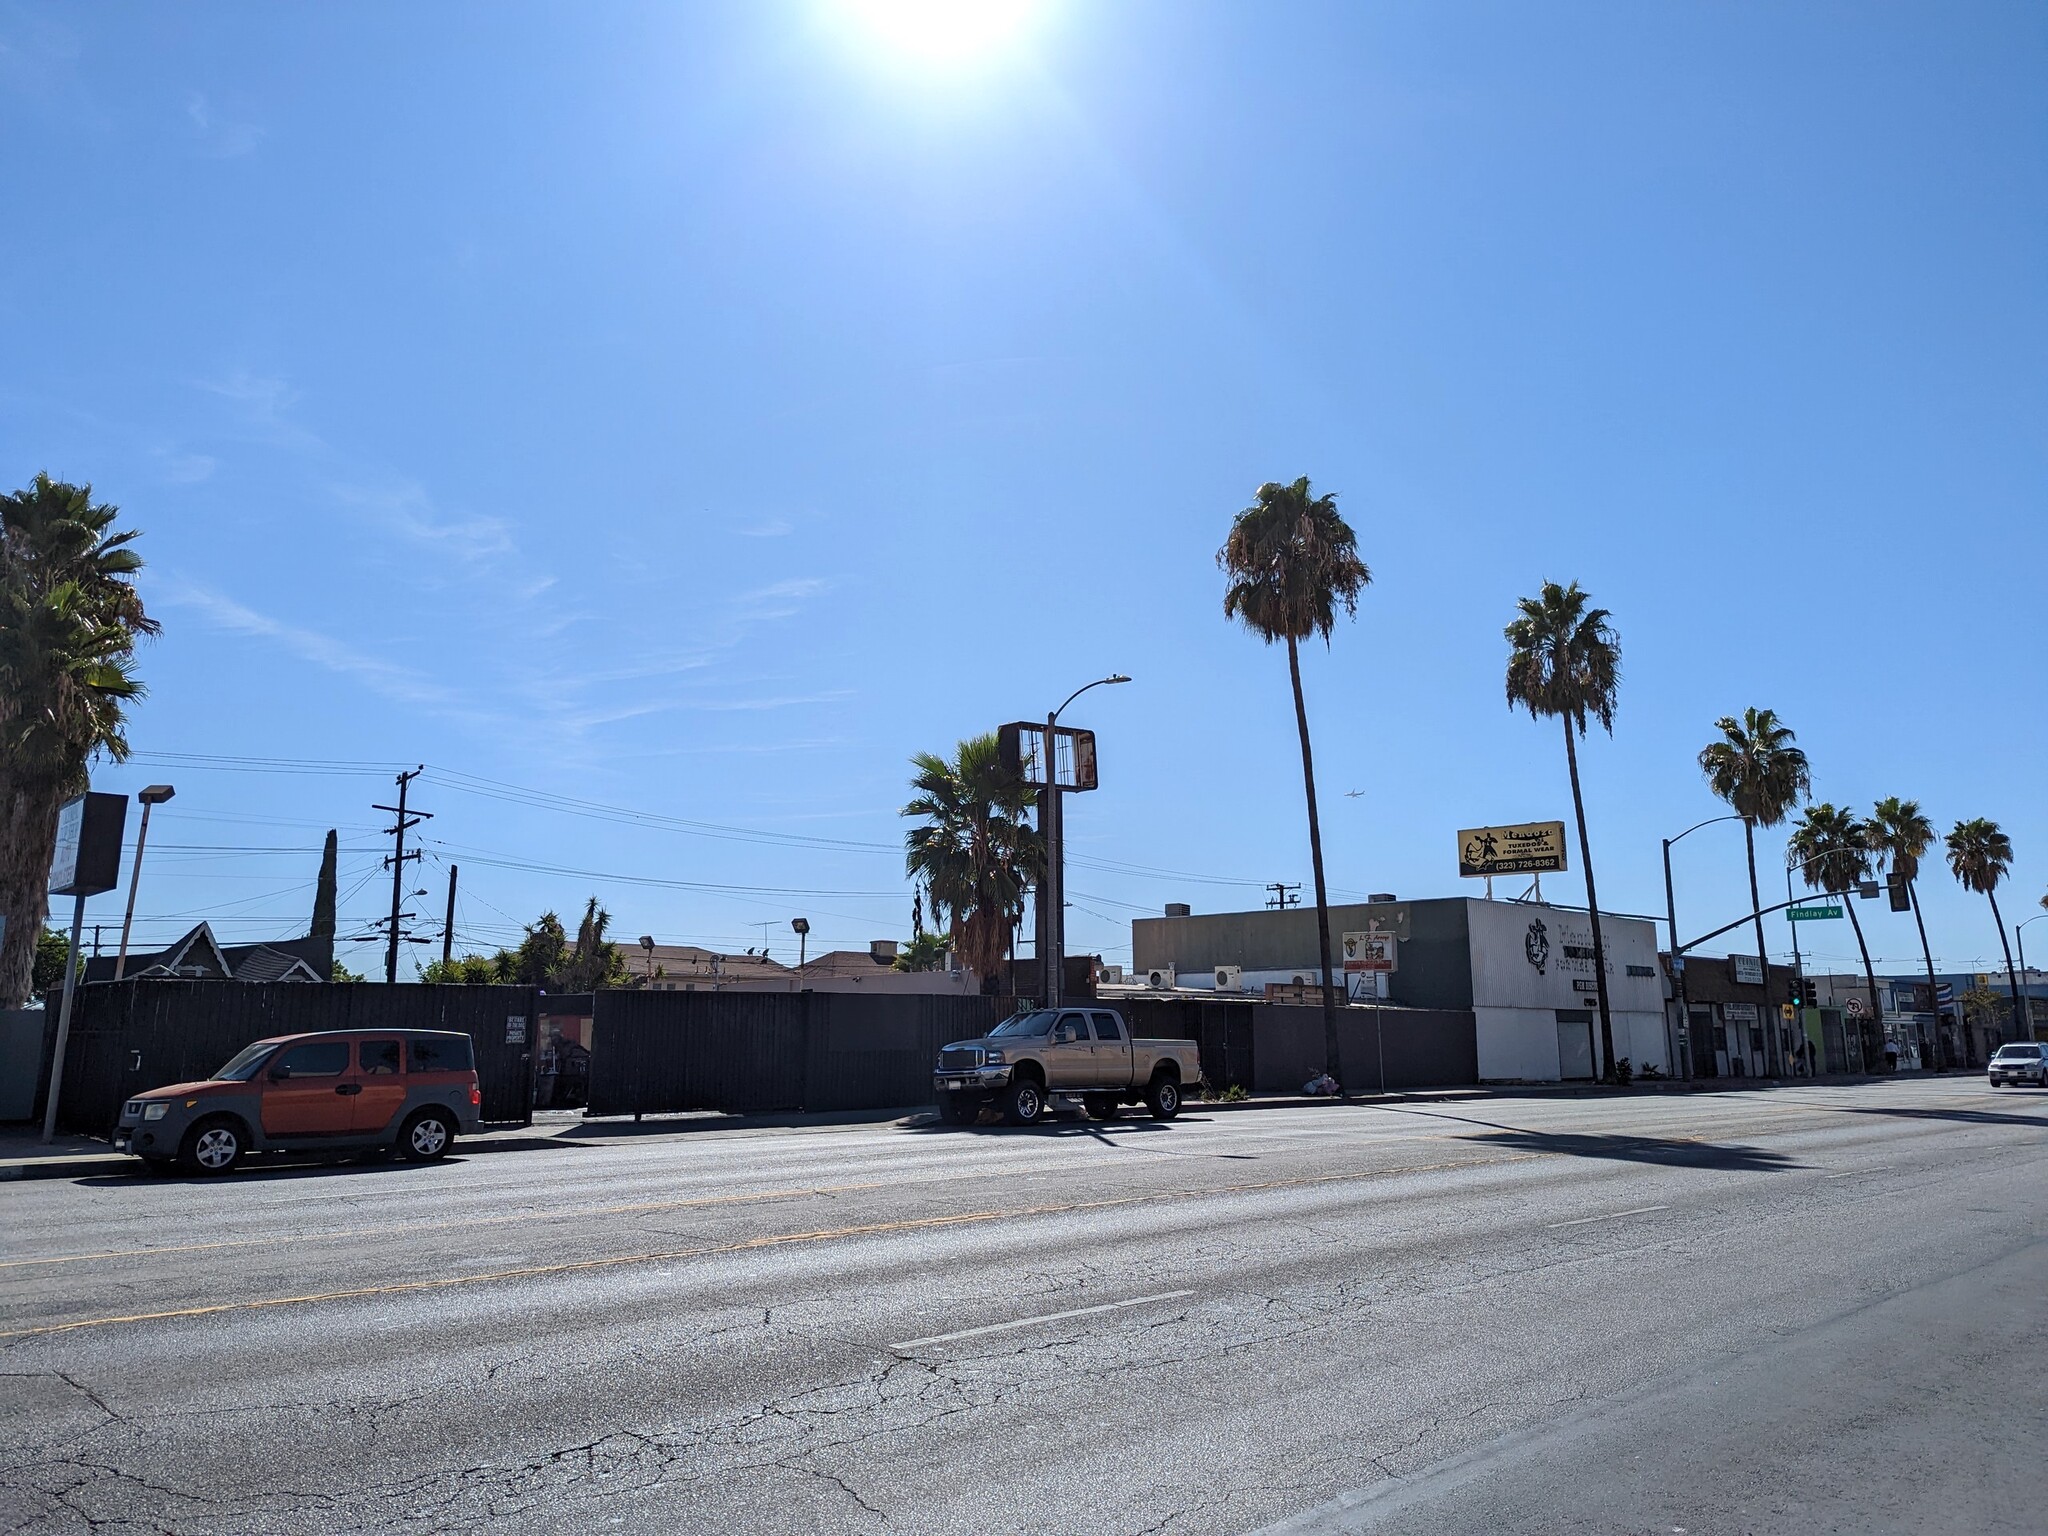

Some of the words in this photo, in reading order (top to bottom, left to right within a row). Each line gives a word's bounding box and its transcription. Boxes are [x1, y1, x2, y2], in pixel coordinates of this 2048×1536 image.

[1496, 861, 1516, 871] (323)
[1518, 859, 1555, 868] 726-8362
[1791, 910, 1823, 918] Findlay
[1738, 957, 1760, 966] CLINIC
